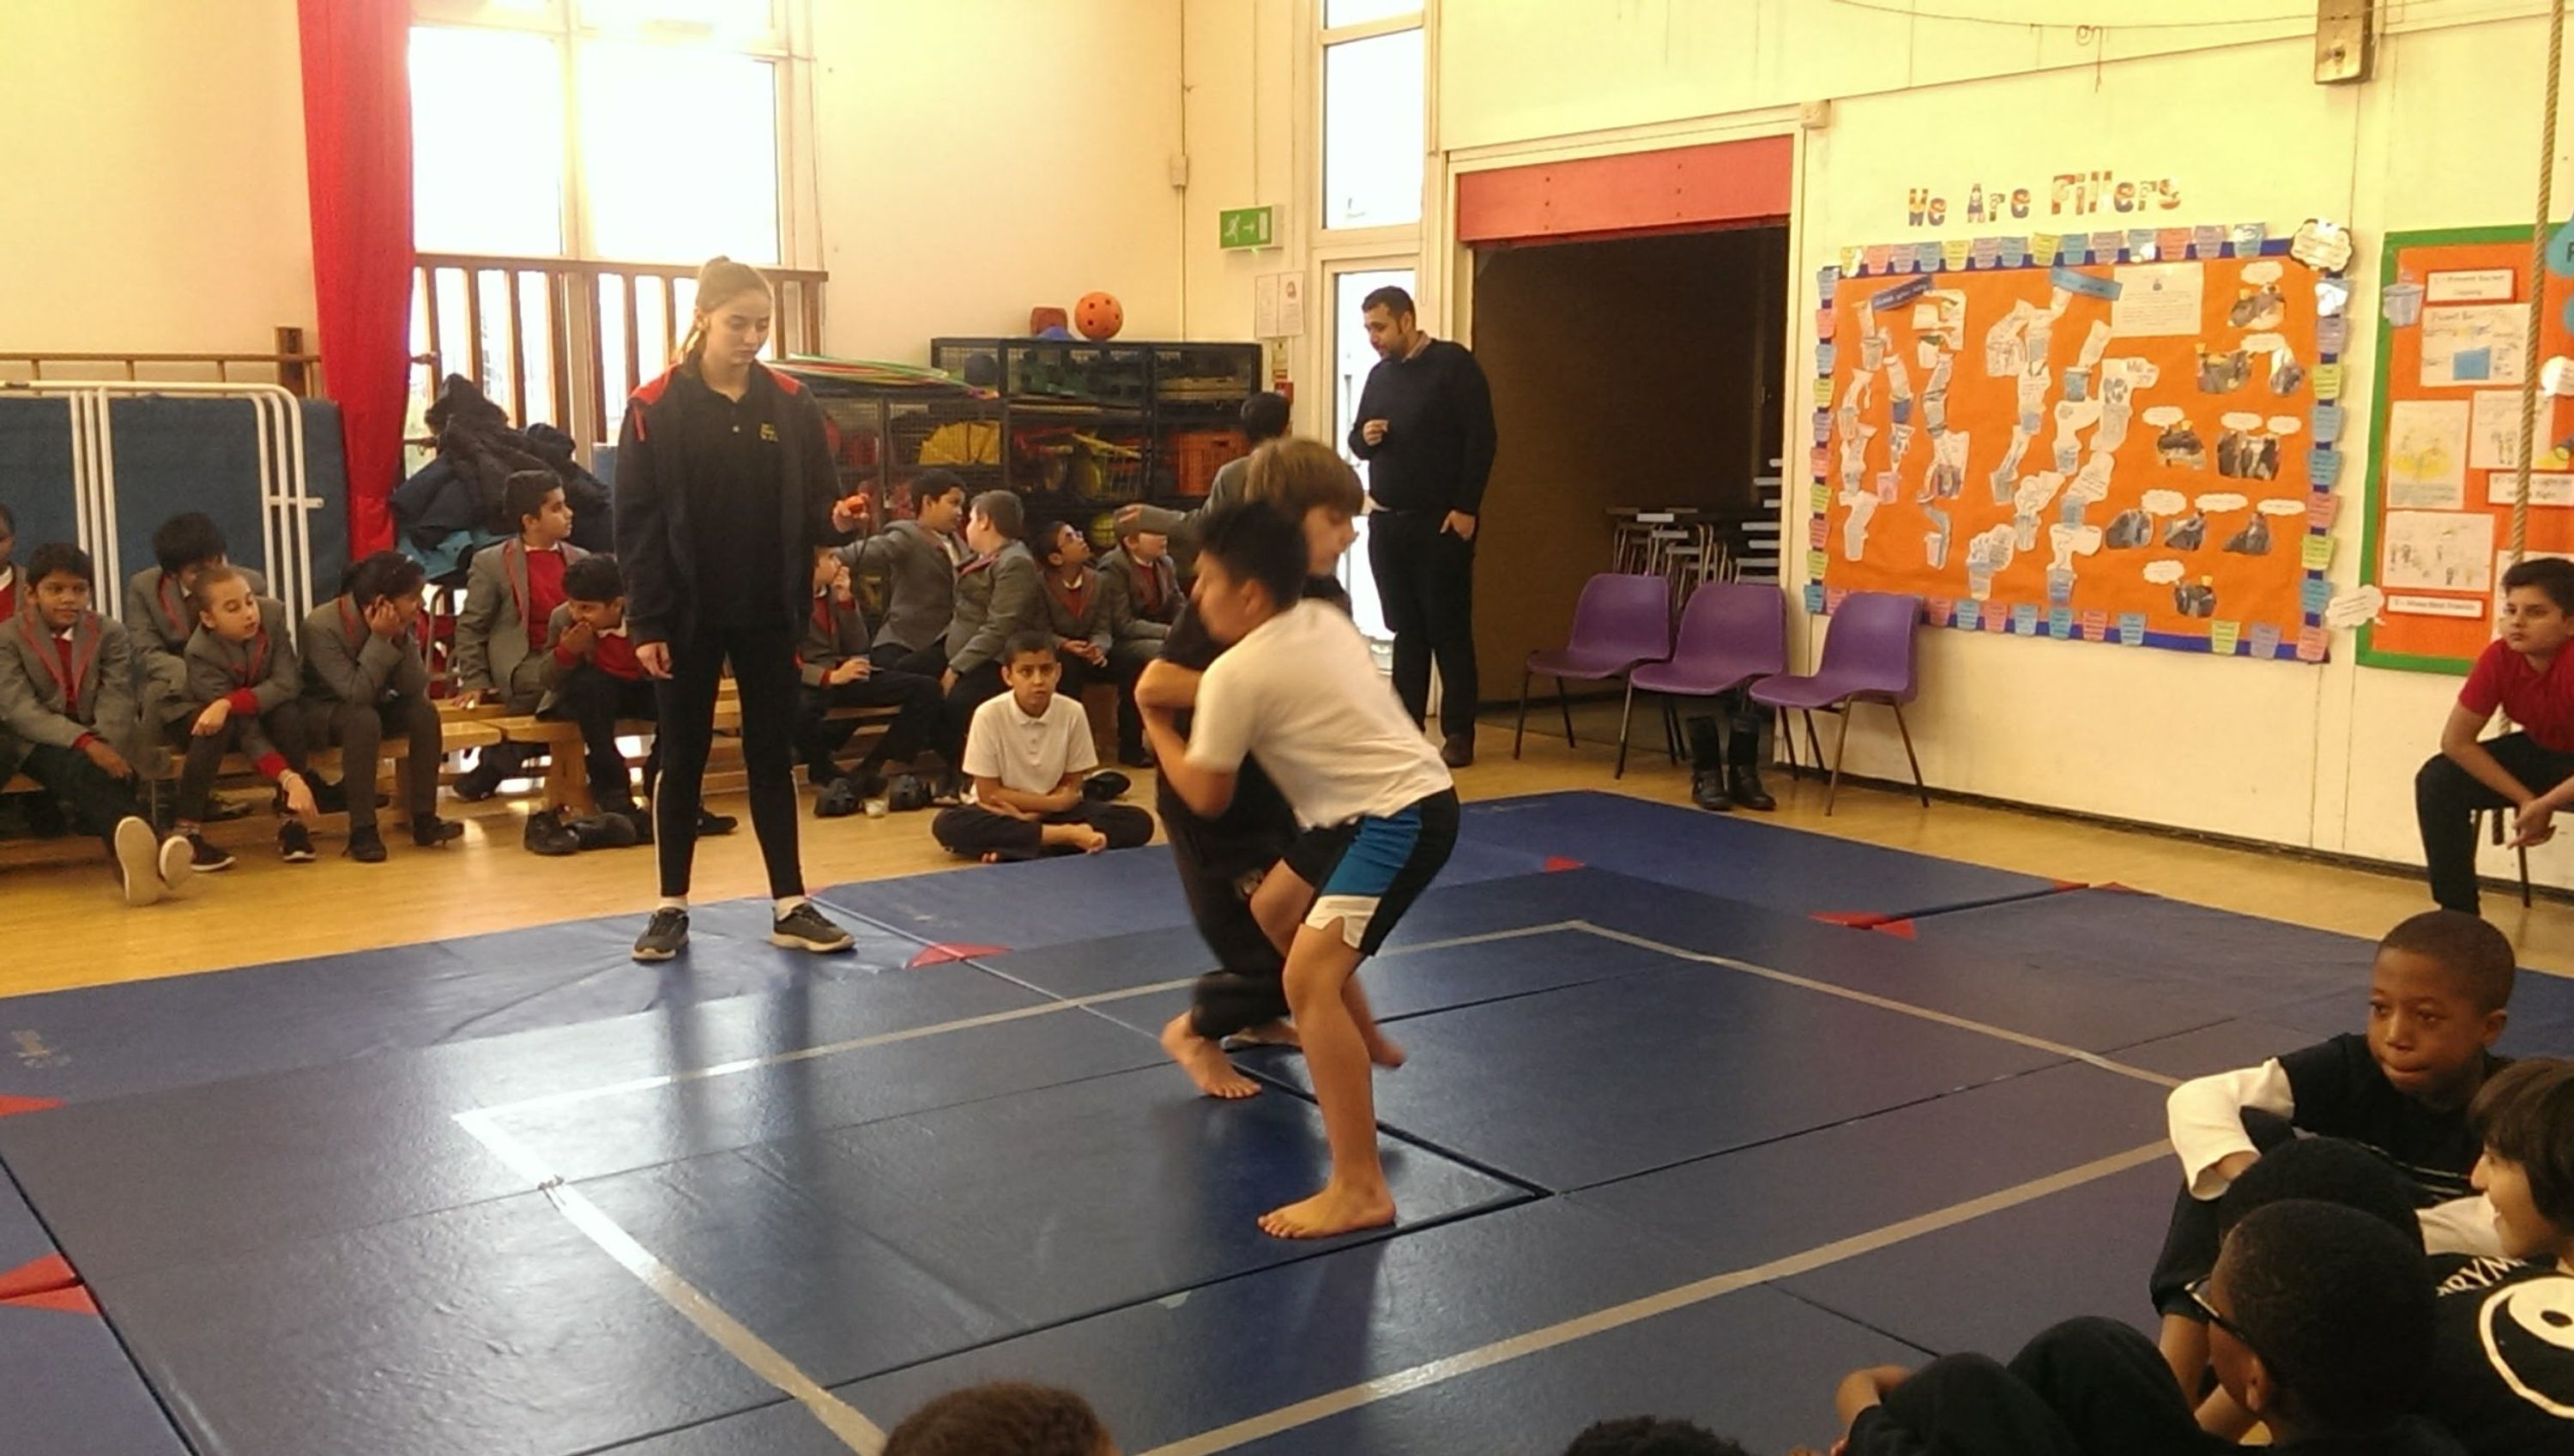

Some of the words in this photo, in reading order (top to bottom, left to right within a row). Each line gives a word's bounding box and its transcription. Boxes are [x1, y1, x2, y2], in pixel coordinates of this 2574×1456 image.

[1909, 189, 1946, 227] We
[1967, 184, 2031, 223] Are
[2051, 171, 2181, 215] Fillers
